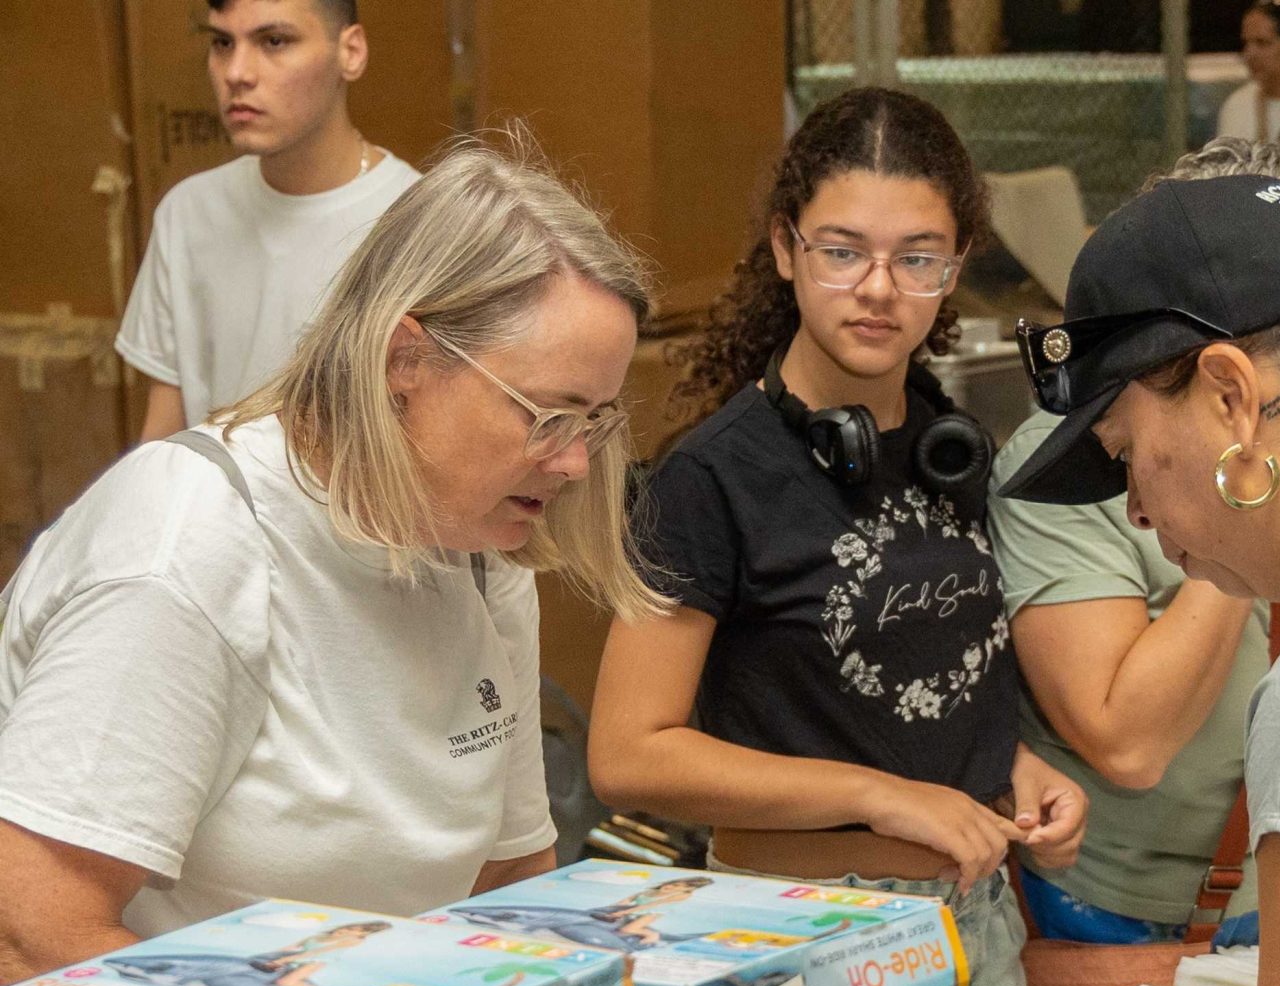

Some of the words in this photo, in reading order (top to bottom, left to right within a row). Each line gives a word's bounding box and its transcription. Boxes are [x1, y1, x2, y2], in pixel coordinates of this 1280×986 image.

[877, 580, 931, 632] Kind
[934, 569, 989, 618] Soul
[448, 733, 470, 747] THE
[470, 711, 519, 742] RITZ-CAR
[449, 735, 504, 758] COMMUNITY
